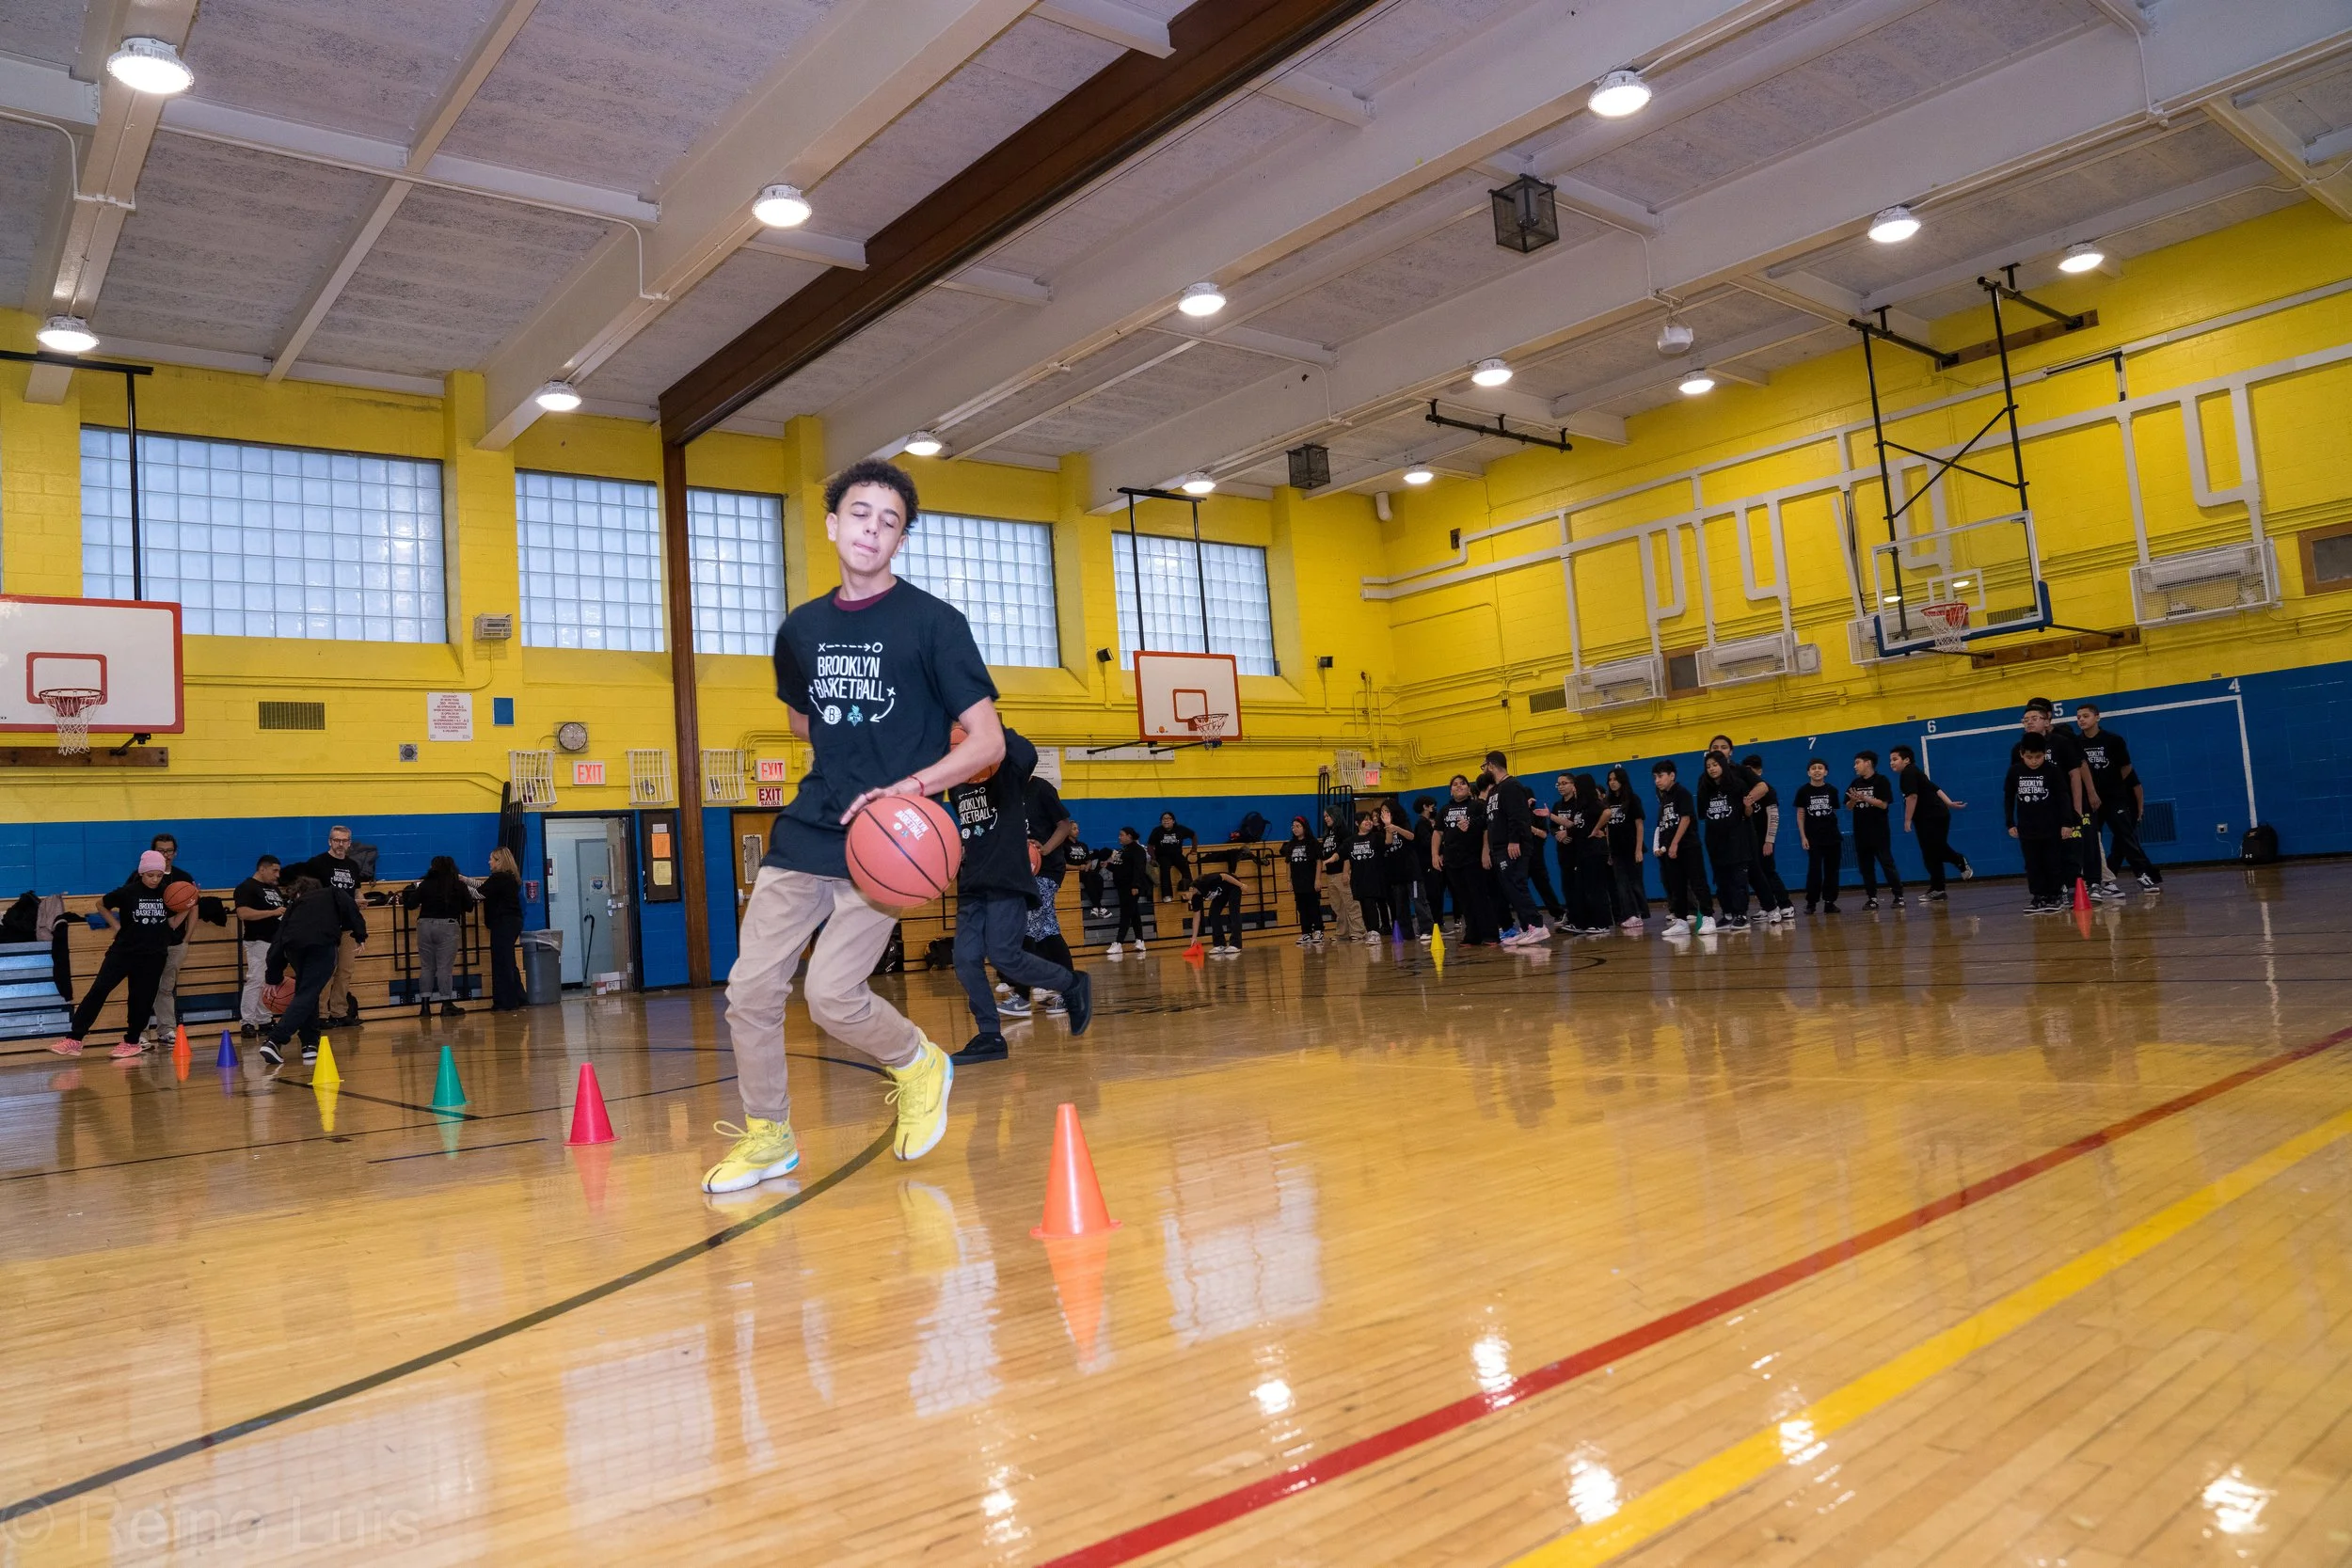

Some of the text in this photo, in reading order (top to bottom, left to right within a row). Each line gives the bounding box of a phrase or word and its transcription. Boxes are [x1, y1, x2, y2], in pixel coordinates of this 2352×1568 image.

[818, 656, 881, 678] BROOKLYN
[2228, 677, 2241, 693] 4
[2052, 703, 2064, 717] 5
[1927, 720, 1937, 733] 6
[1808, 736, 1817, 750] 7
[577, 764, 603, 783] EXIT
[760, 763, 784, 780] EXIT
[1365, 770, 1378, 784] EXIT
[758, 788, 782, 800] EXIT
[135, 909, 166, 917] BASKETBALL
